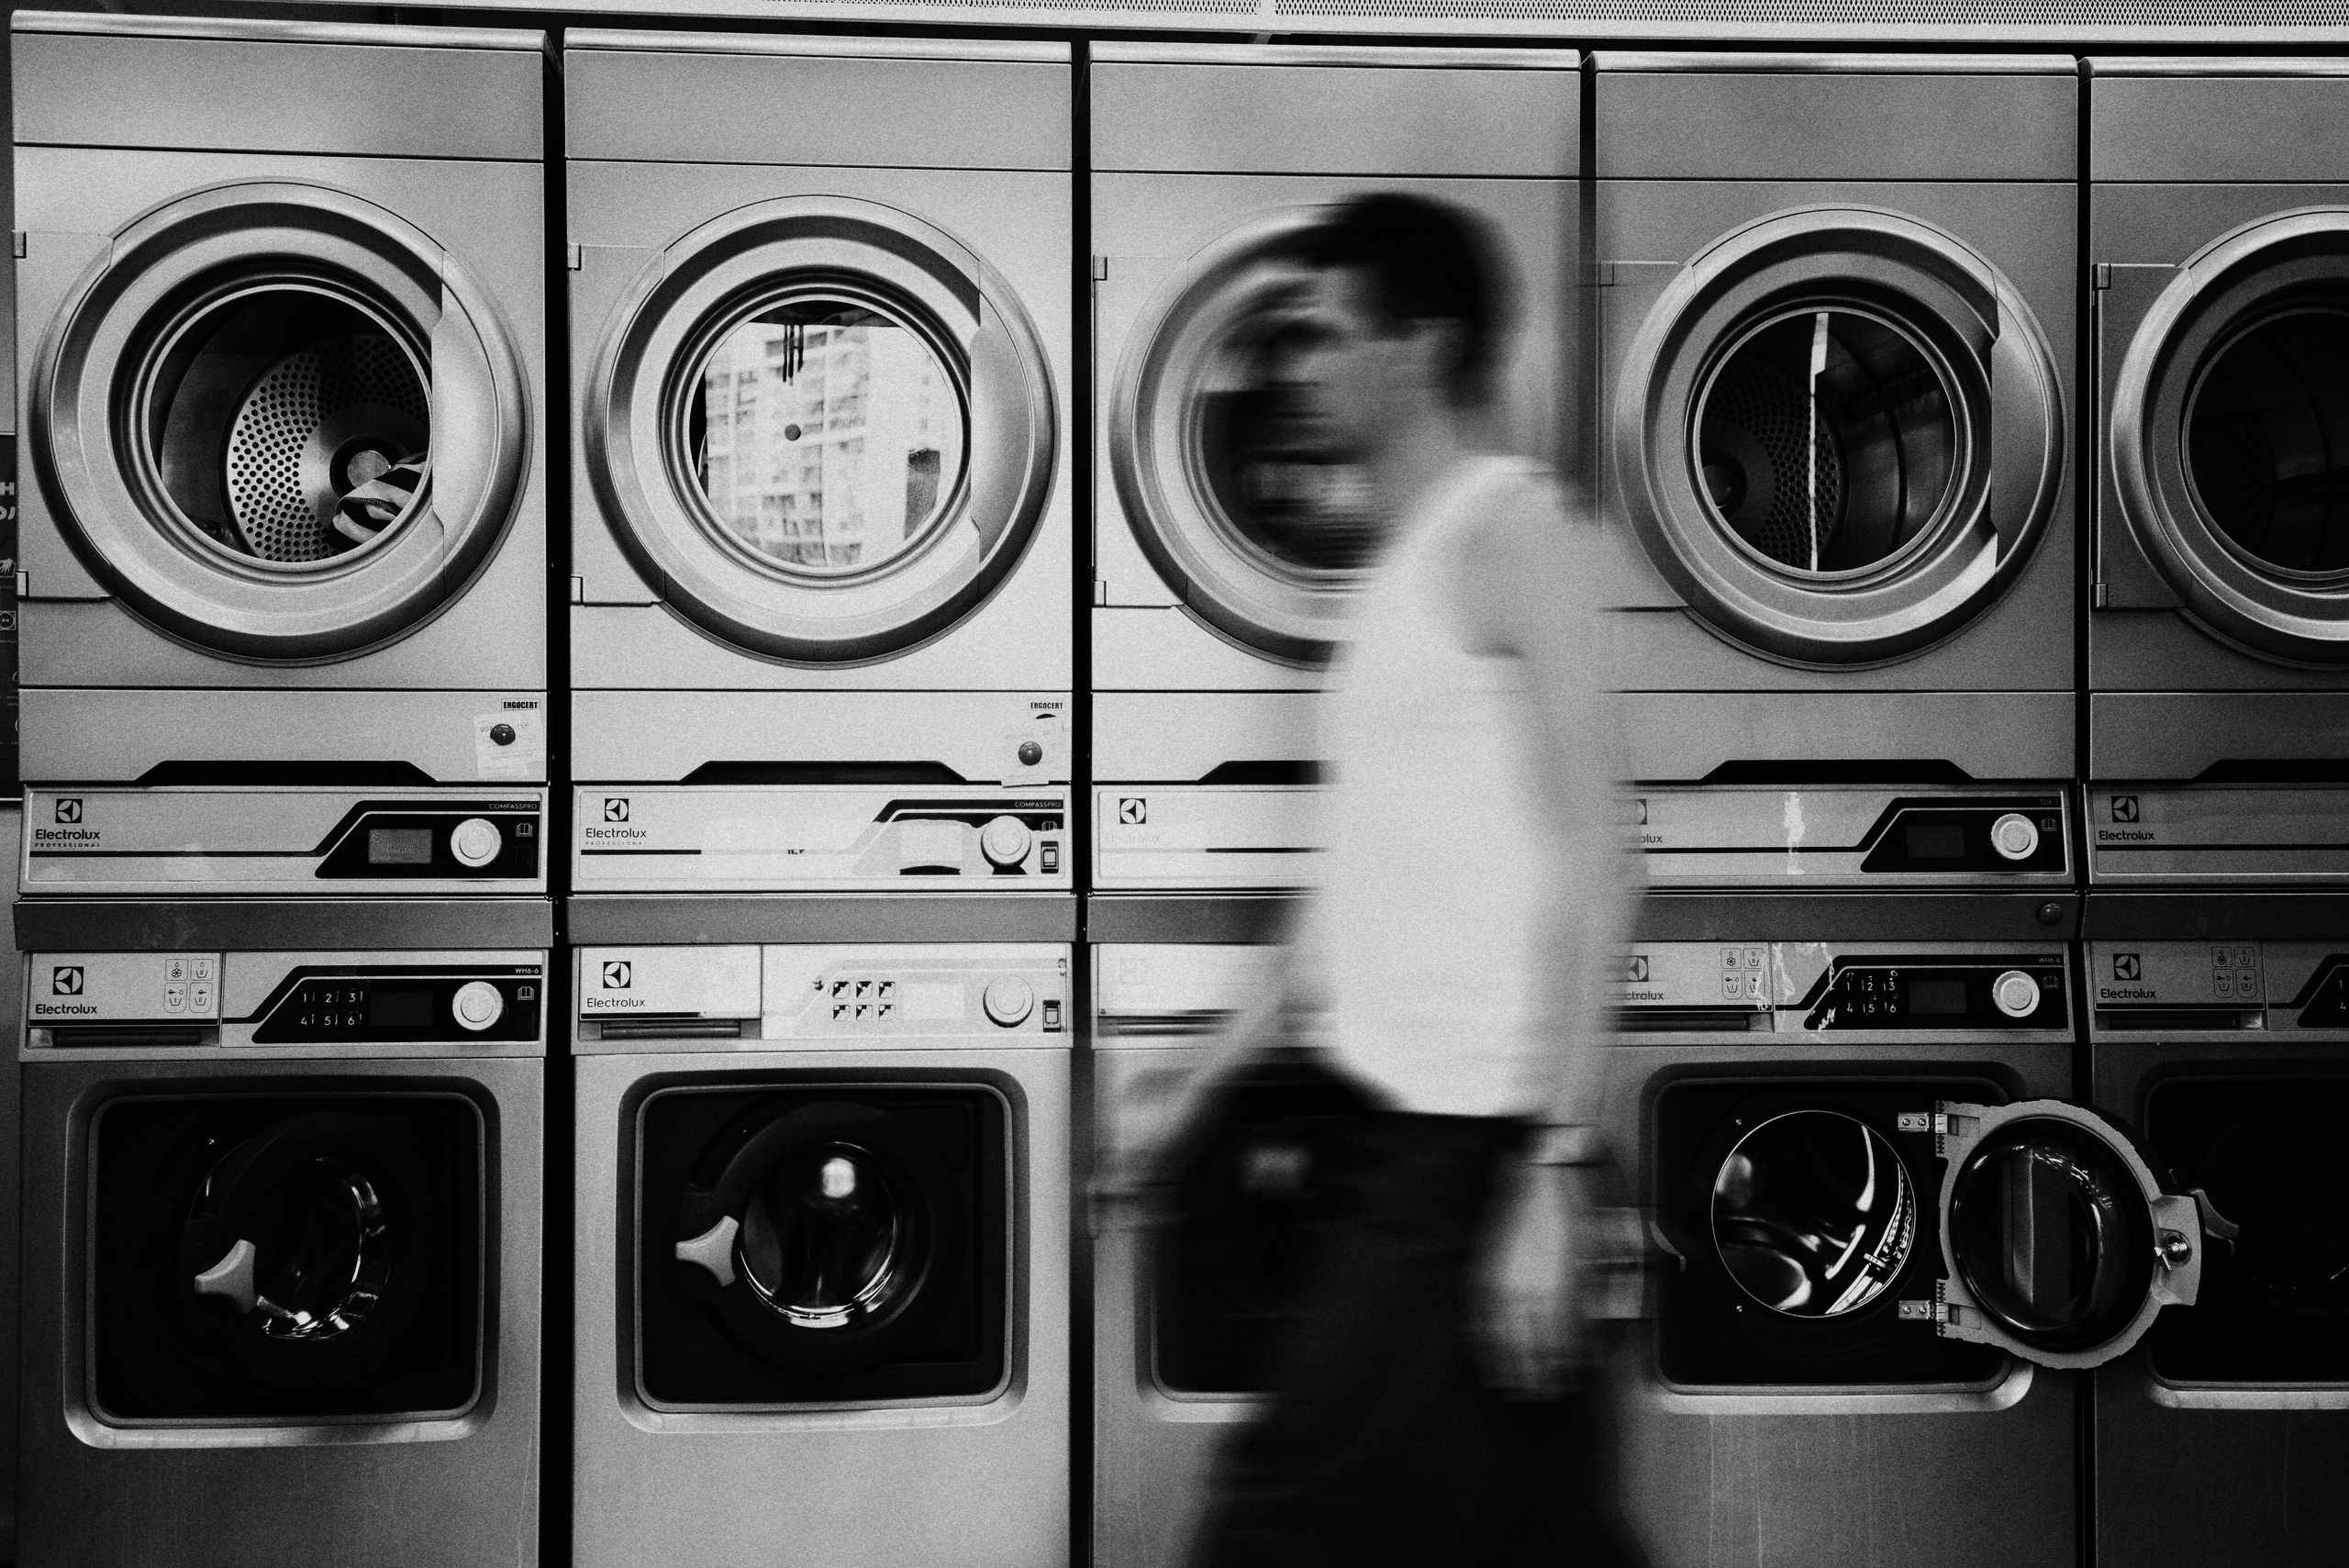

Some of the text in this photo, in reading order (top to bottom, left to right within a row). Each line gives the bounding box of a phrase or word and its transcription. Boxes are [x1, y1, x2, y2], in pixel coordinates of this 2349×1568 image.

[503, 701, 539, 709] ERGOCERT
[35, 828, 101, 840] Electrolux
[585, 828, 647, 839] Electrolux
[2099, 830, 2155, 840] Electrolux
[1846, 981, 1896, 991] 1 2 3
[303, 993, 356, 1003] 1 2 3
[2100, 988, 2156, 998] Electrolux
[586, 997, 645, 1008] Electrolux
[1846, 1002, 1897, 1013] 4 5 6
[2340, 1002, 2346, 1010] 4
[35, 1003, 98, 1015] Electrolux
[300, 1016, 355, 1026] 4 5 6
